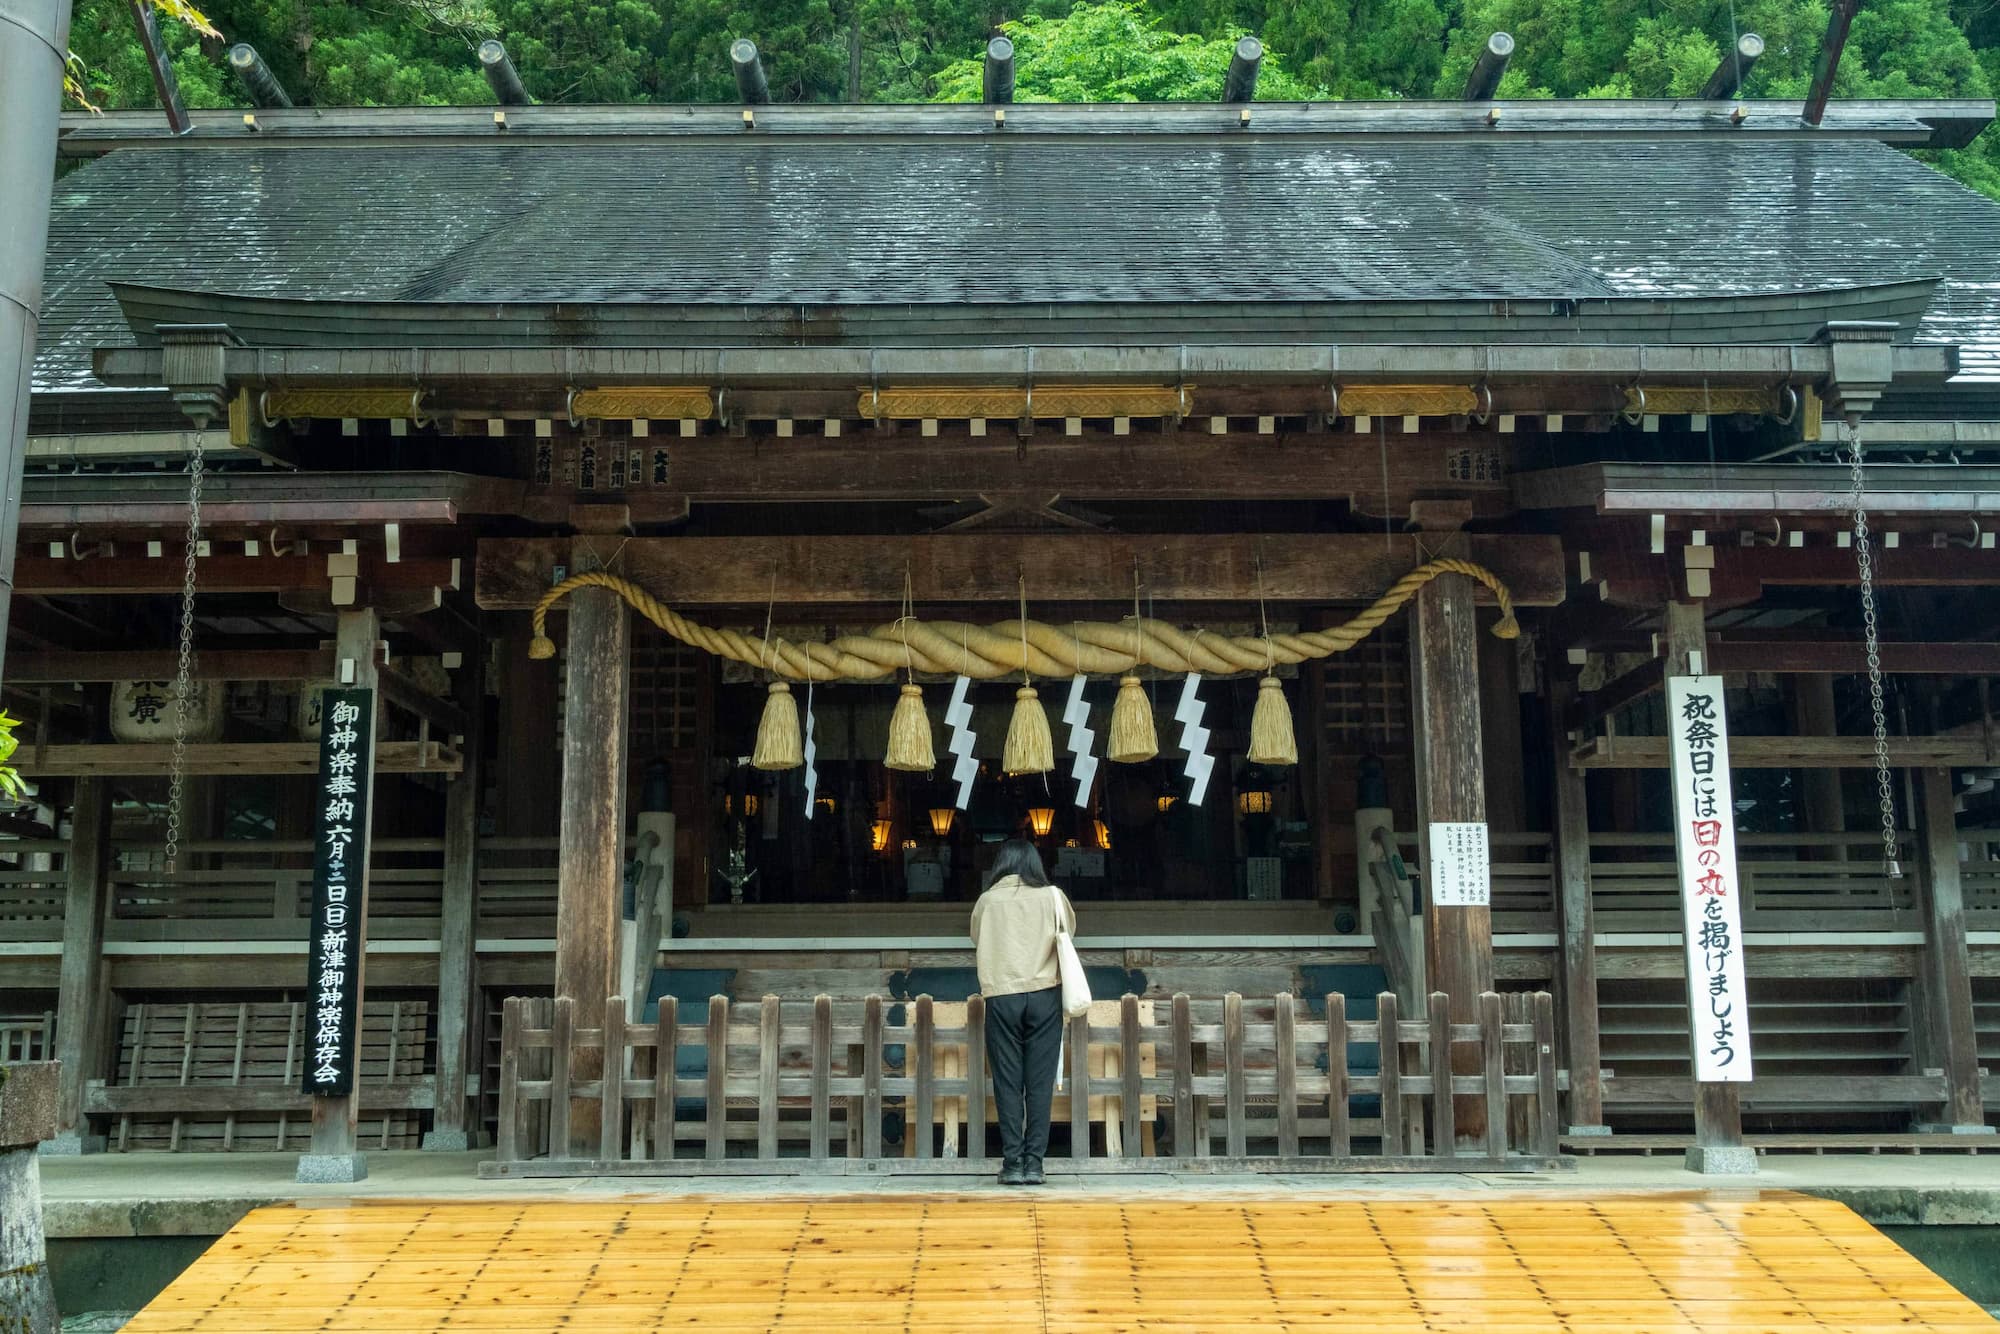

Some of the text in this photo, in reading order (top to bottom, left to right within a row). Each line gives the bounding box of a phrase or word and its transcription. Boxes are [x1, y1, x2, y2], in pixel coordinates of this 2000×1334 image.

[1681, 692, 1734, 1067] 祝祭日には日の丸を掲げましょう
